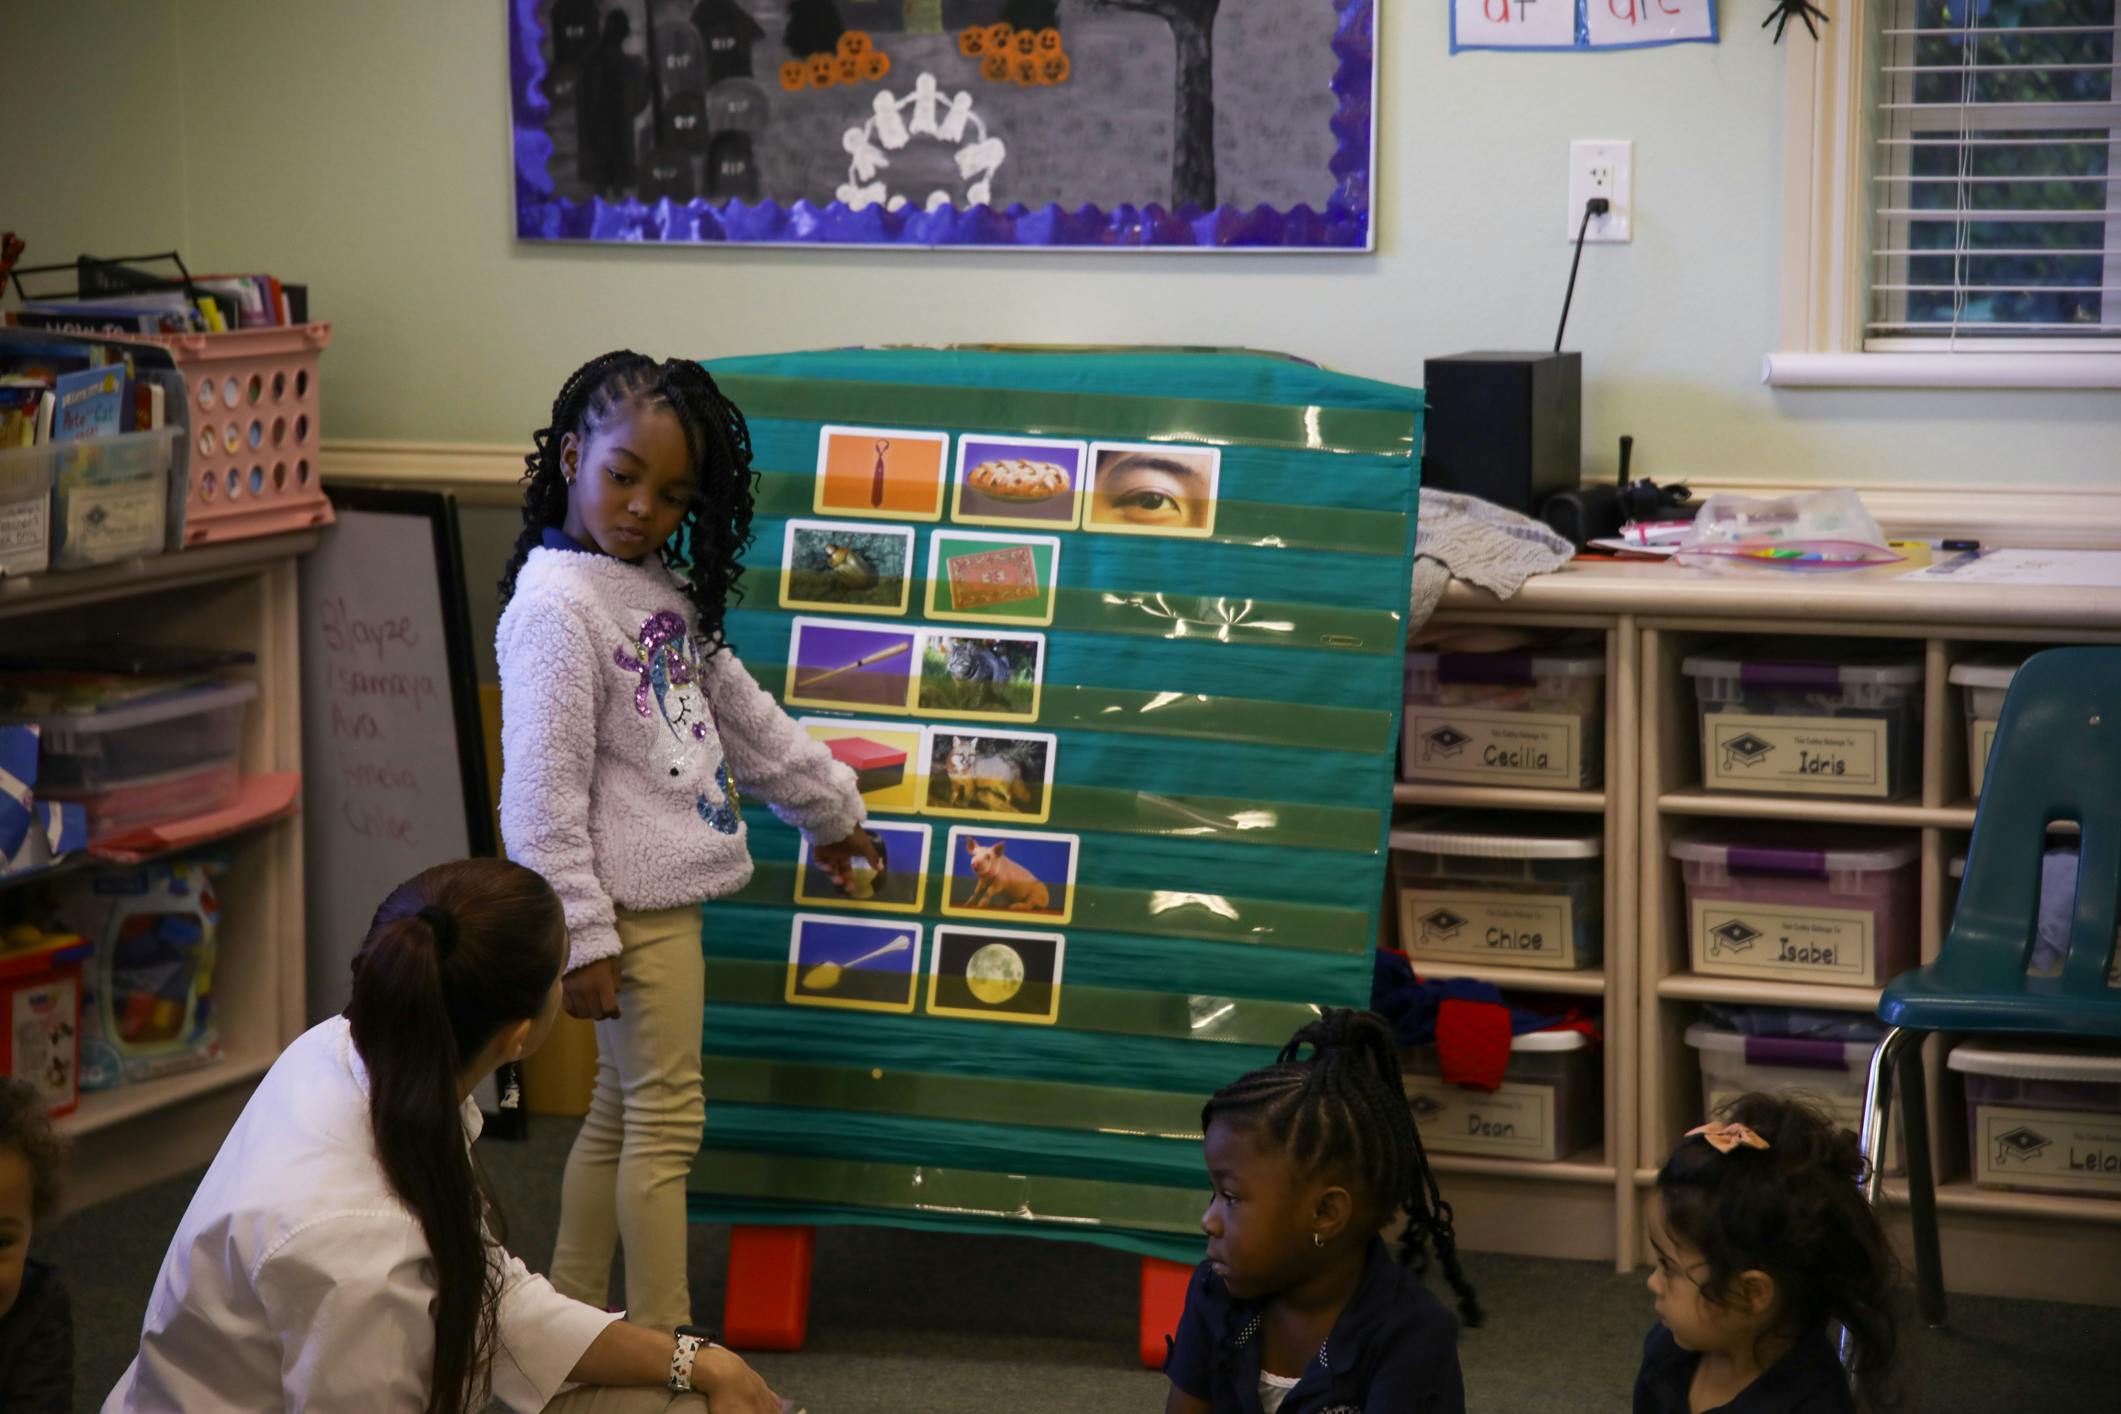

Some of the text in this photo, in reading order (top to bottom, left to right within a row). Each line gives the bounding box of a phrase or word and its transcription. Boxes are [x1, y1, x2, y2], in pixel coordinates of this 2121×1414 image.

[711, 38, 736, 51] RIP
[666, 54, 691, 69] RIP
[721, 161, 745, 175] RIP
[1484, 744, 1548, 769] Cecilia
[1799, 750, 1845, 775] Idris
[1485, 927, 1542, 950] Chloe
[1778, 937, 1837, 965] Isabel
[1468, 1113, 1514, 1138] Dean
